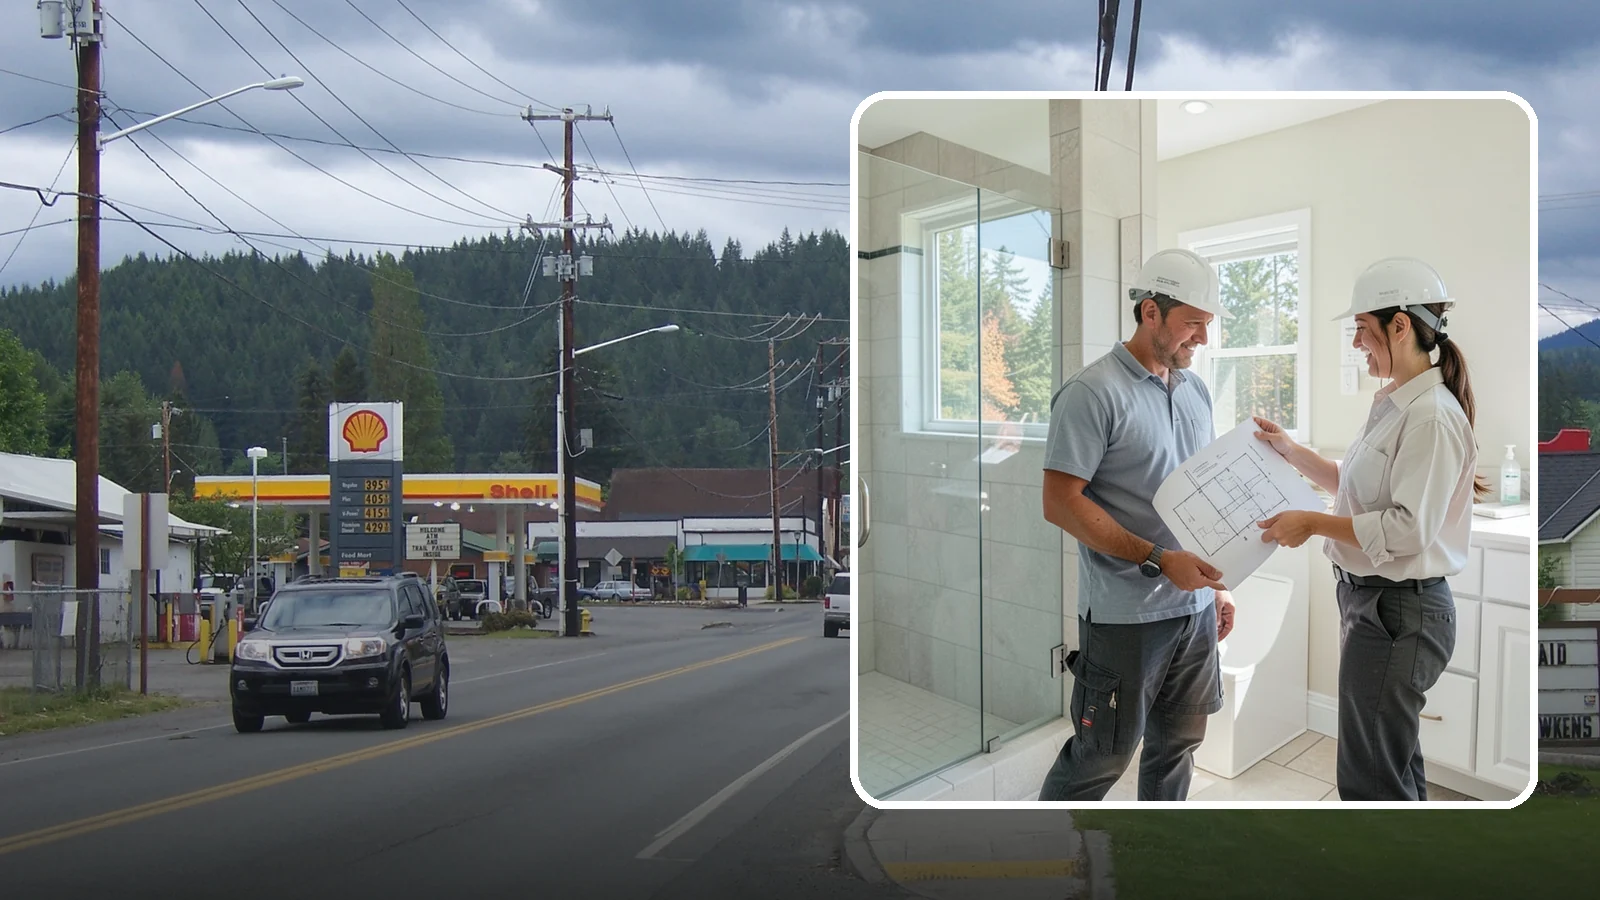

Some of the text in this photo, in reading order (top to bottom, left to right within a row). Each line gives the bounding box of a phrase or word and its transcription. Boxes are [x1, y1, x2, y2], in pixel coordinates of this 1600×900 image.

[366, 480, 383, 490] 395
[490, 484, 547, 499] Shell
[366, 494, 383, 504] 405
[366, 508, 383, 518] 415
[366, 522, 383, 532] 429
[1539, 716, 1592, 739] WKENS
